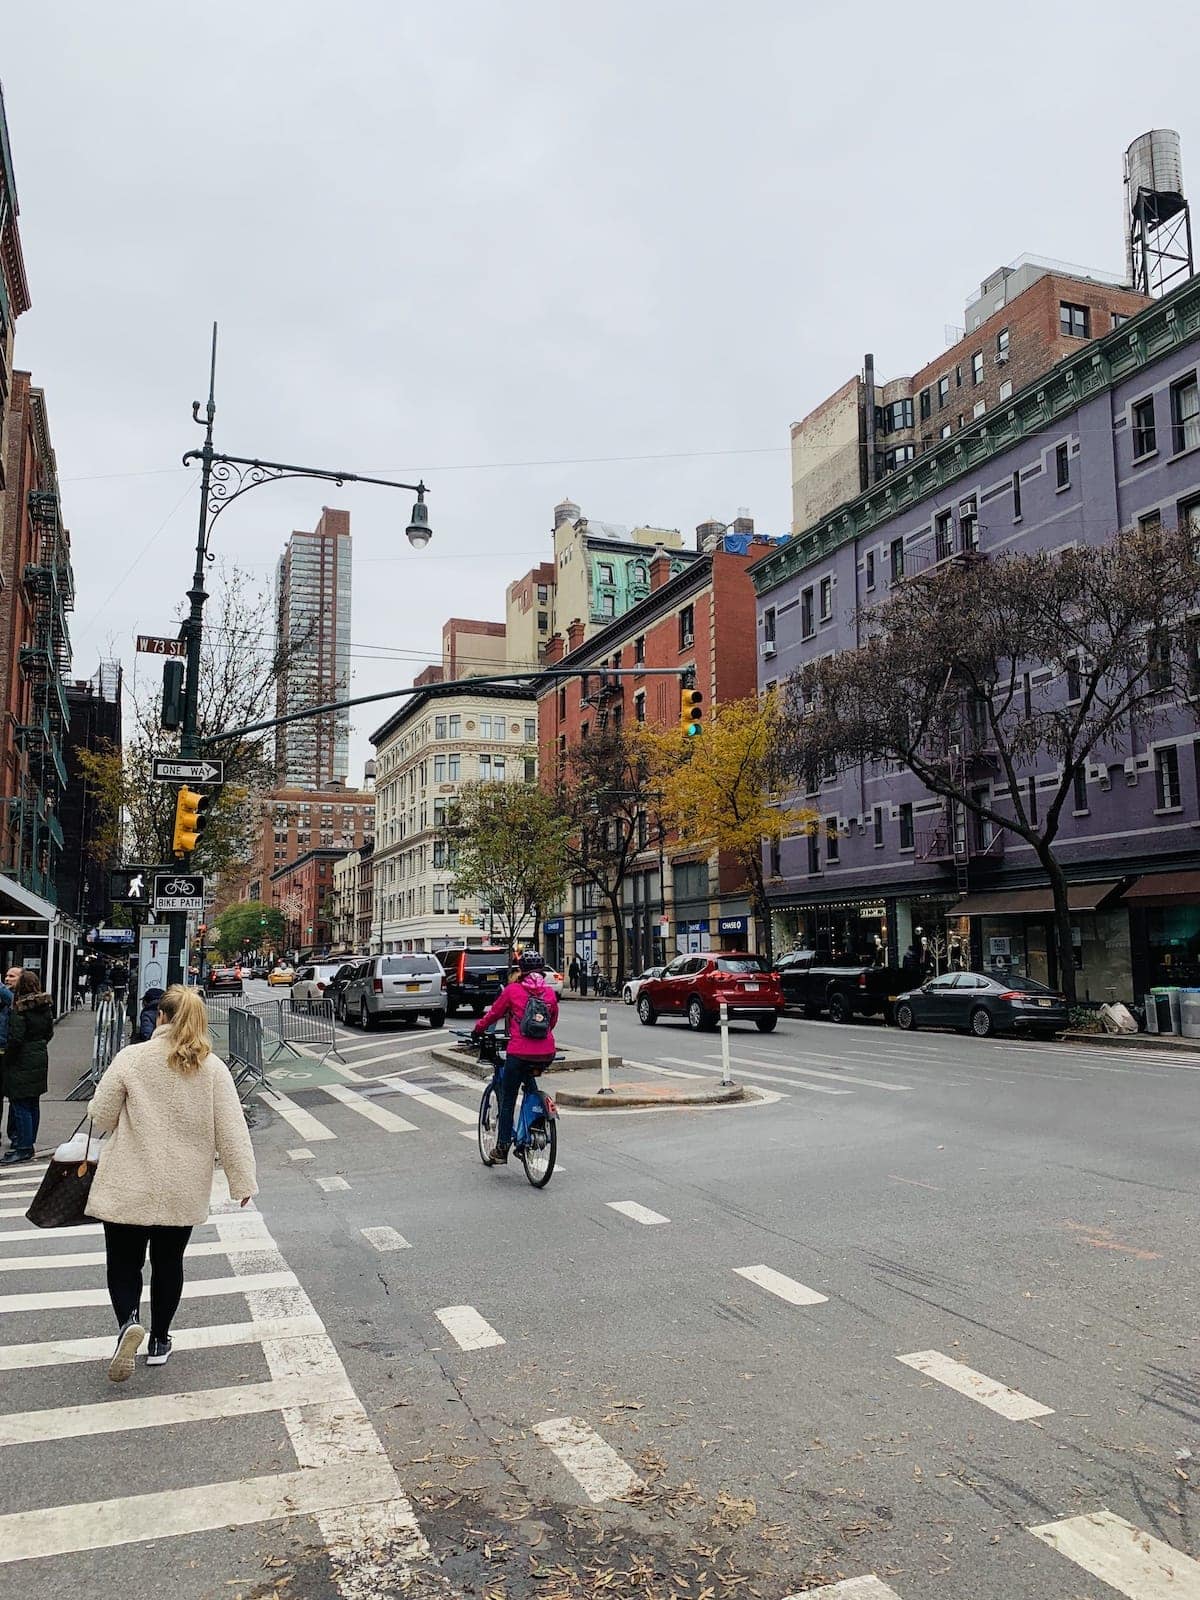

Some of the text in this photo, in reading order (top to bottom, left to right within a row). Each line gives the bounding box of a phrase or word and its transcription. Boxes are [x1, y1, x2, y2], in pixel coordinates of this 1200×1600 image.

[140, 639, 182, 655] W 73 ST
[162, 765, 212, 776] ONE WAY
[158, 898, 200, 907] BIKE PATH
[722, 922, 737, 930] CHASE
